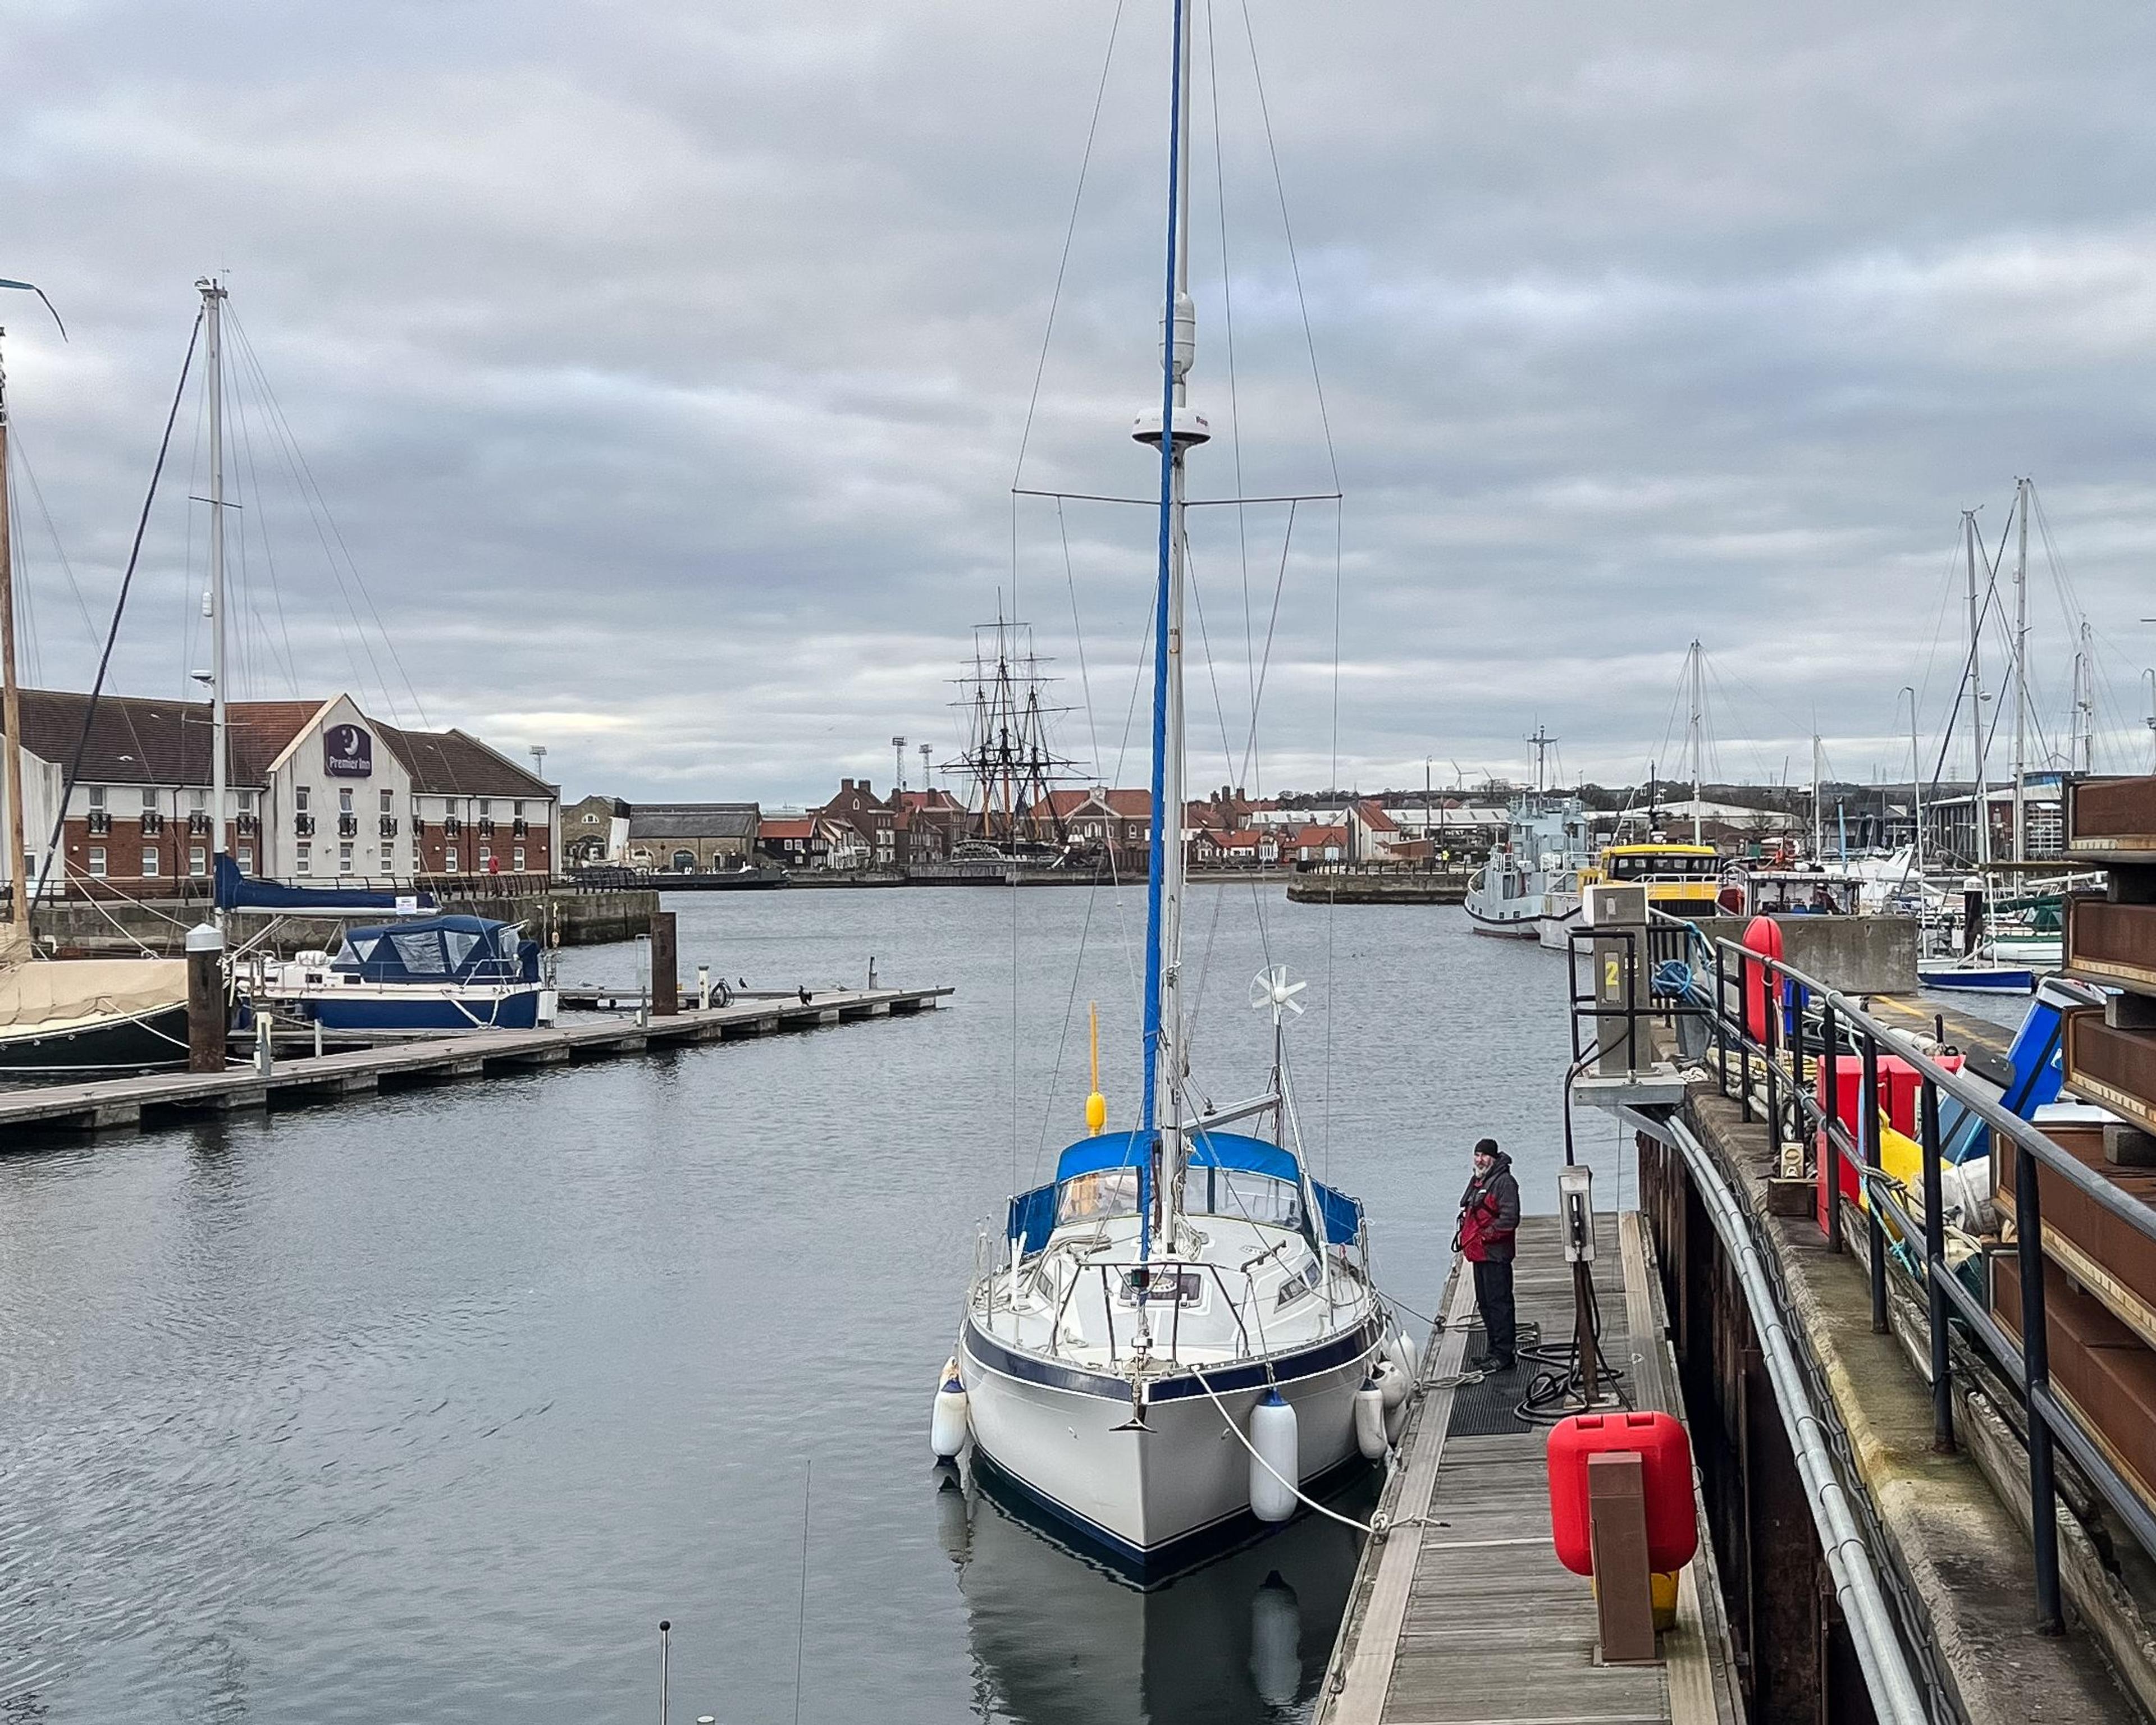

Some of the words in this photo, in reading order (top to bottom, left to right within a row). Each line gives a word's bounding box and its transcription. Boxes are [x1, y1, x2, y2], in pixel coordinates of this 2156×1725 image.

[330, 756, 358, 770] Premier
[359, 758, 371, 770] Inn
[1605, 961, 1619, 985] 2
